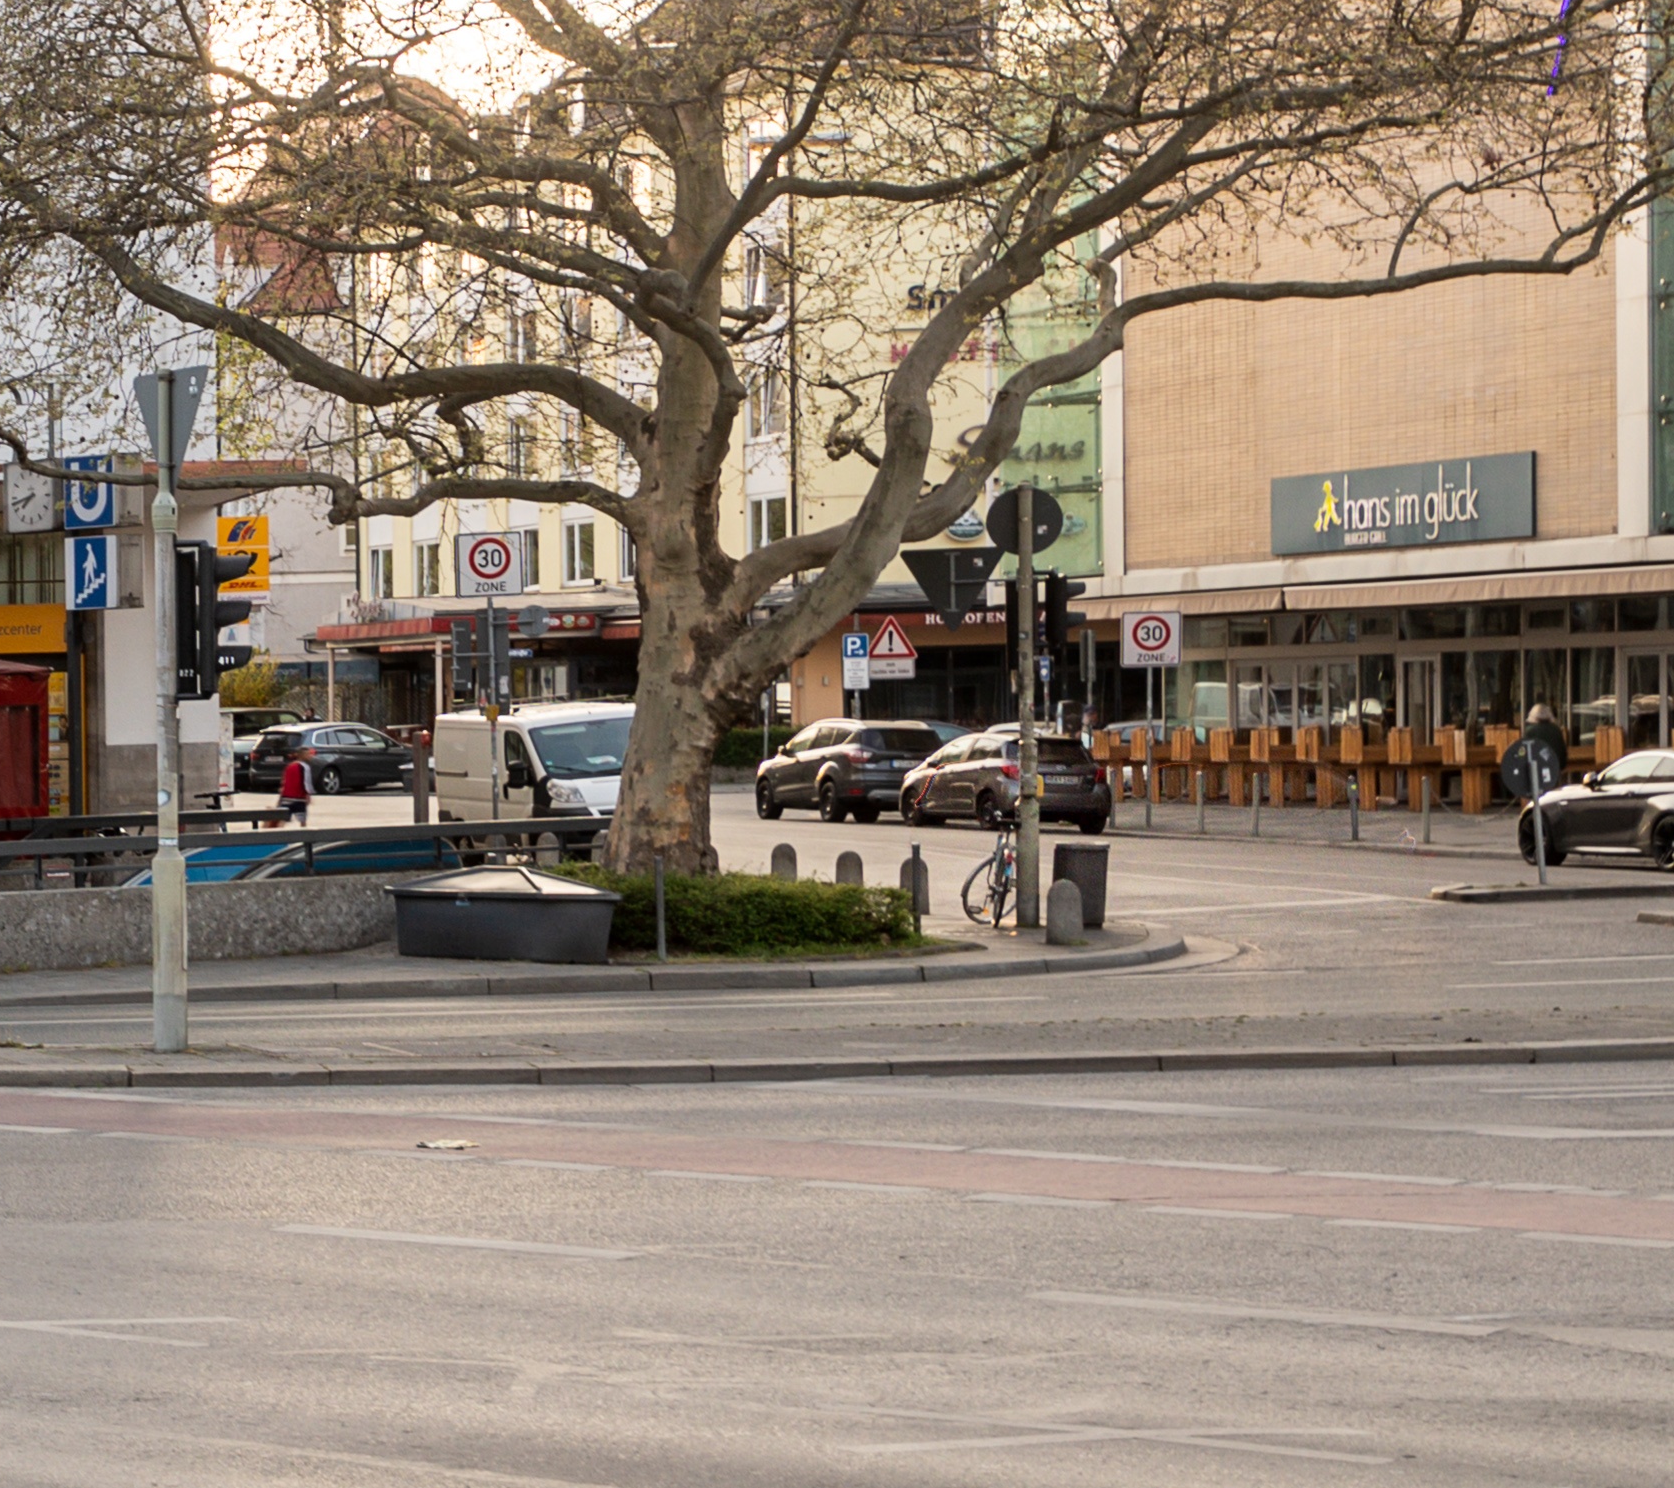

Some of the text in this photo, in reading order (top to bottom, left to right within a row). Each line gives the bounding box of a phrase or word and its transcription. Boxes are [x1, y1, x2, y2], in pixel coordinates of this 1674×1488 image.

[1343, 461, 1479, 540] hans im glück
[477, 548, 503, 568] 30
[475, 581, 507, 592] ZONE
[1140, 625, 1163, 642] 30
[847, 637, 861, 656] P
[1137, 652, 1166, 663] ZONE
